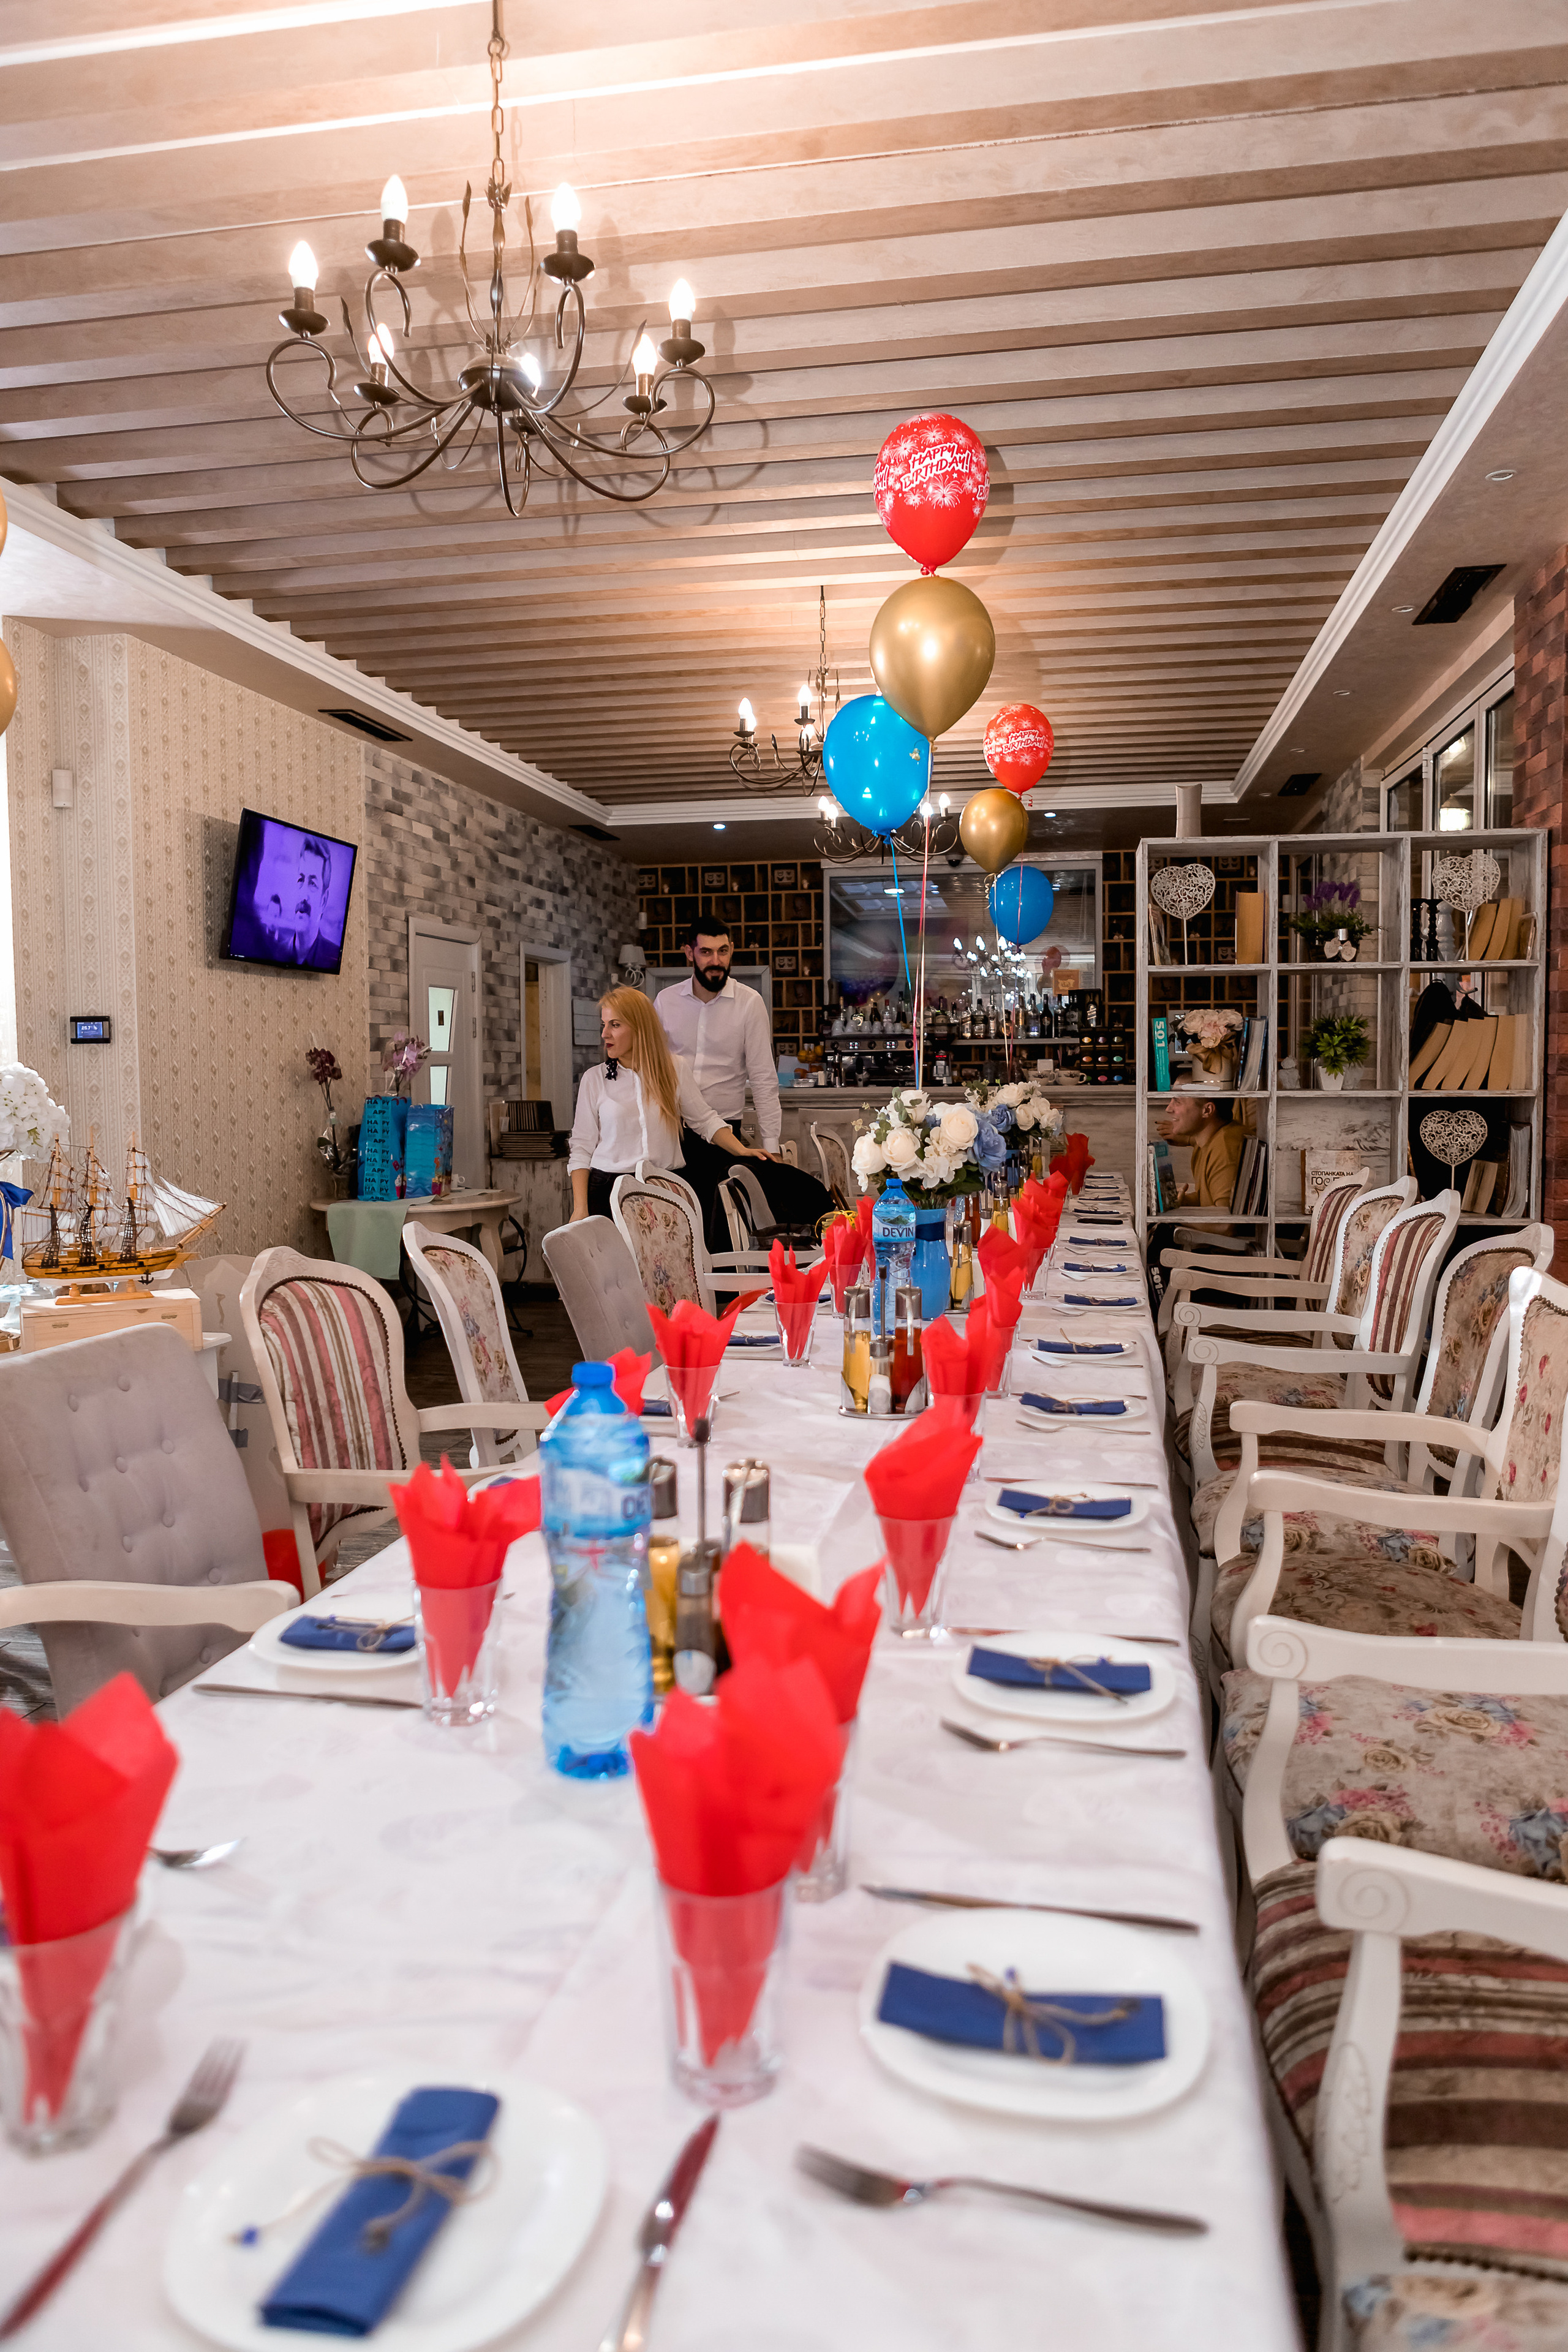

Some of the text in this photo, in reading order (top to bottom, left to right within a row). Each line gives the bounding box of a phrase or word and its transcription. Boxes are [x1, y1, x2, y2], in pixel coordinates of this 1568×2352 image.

[911, 443, 956, 469] HAPPY
[903, 452, 971, 489] BIRTHDAY!
[1003, 736, 1045, 753] BIRTHDAY!
[1011, 731, 1038, 742] HAPPY
[1156, 1020, 1166, 1047] 501
[883, 1227, 914, 1237] DEVIN
